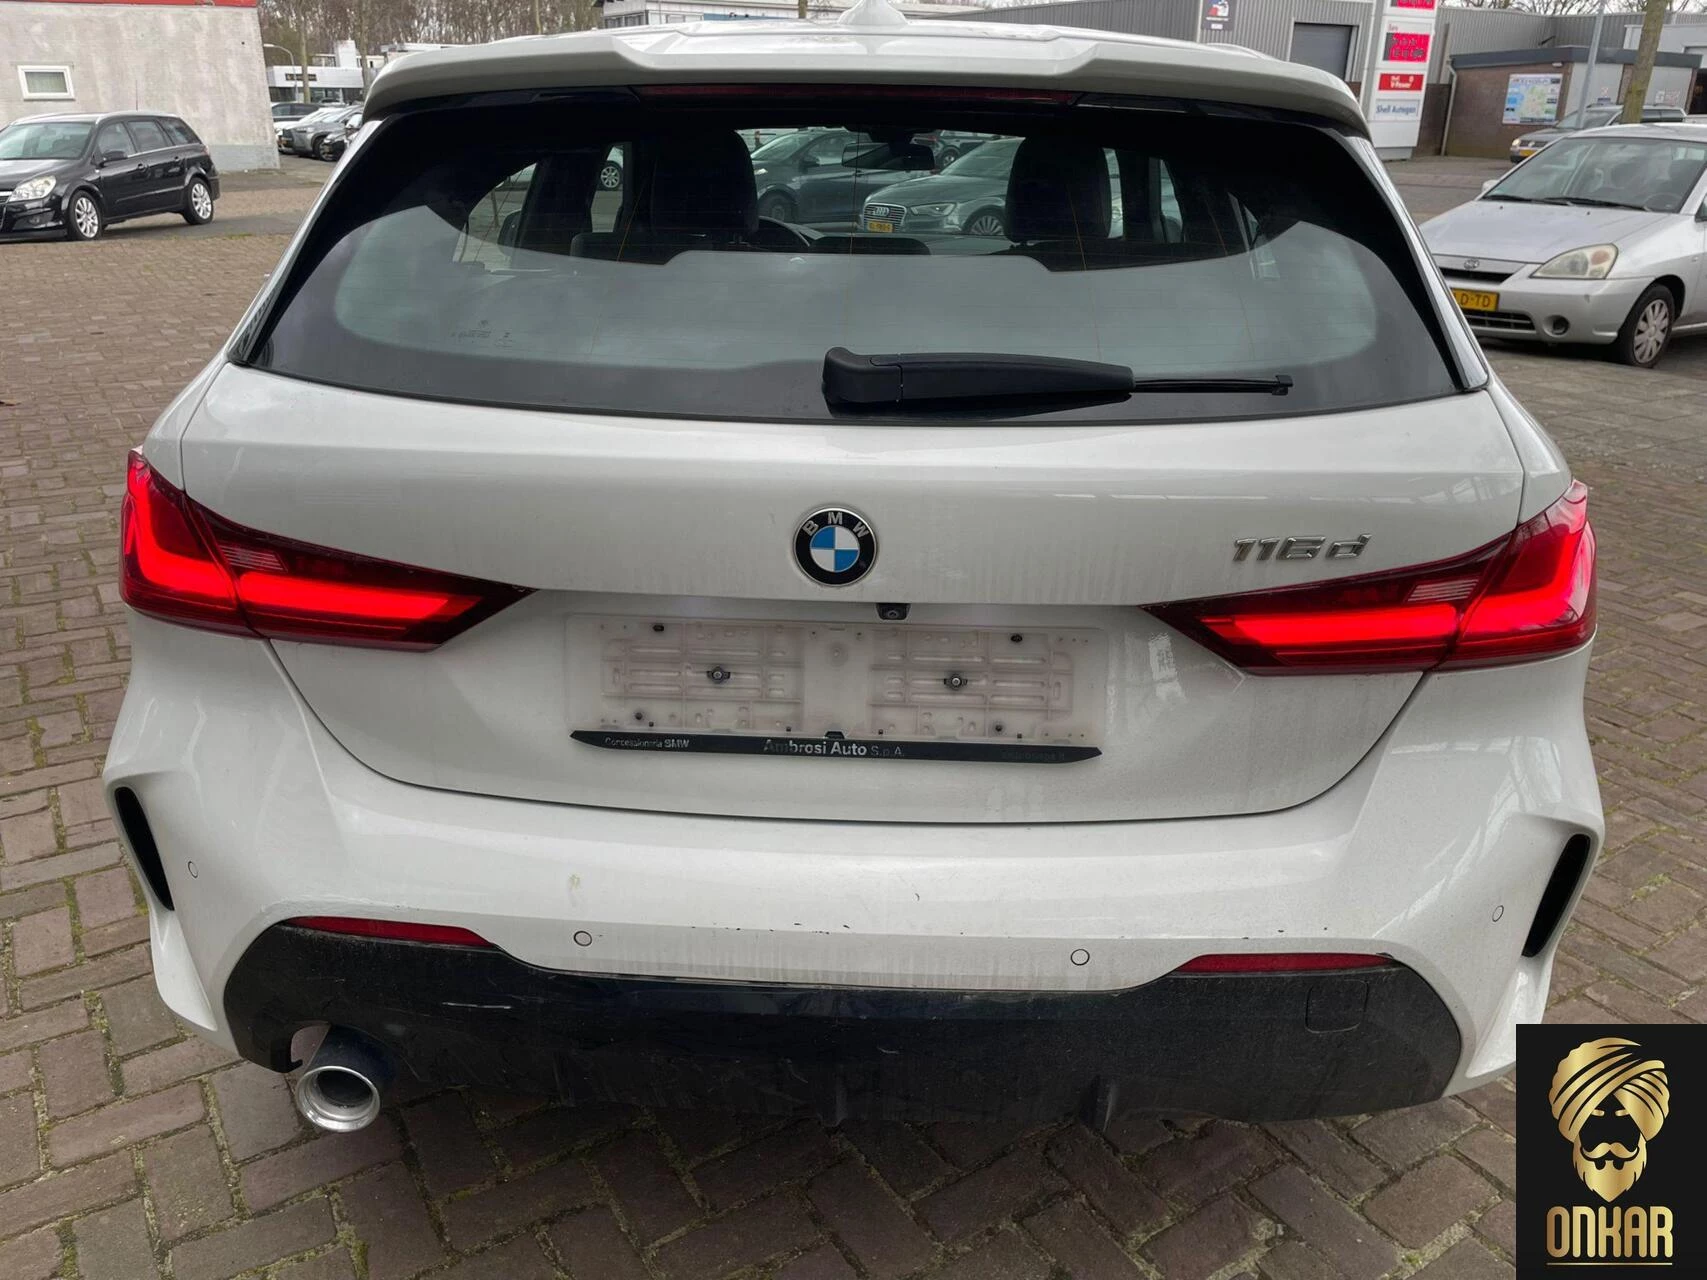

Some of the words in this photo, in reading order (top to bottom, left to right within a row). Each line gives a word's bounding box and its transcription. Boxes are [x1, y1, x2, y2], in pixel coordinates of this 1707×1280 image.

[1454, 291, 1491, 308] D-TD
[801, 511, 870, 538] BMW
[1232, 533, 1372, 561] 116d
[664, 739, 690, 748] BMW
[764, 739, 826, 754] Ambrosi
[831, 741, 867, 756] Auto
